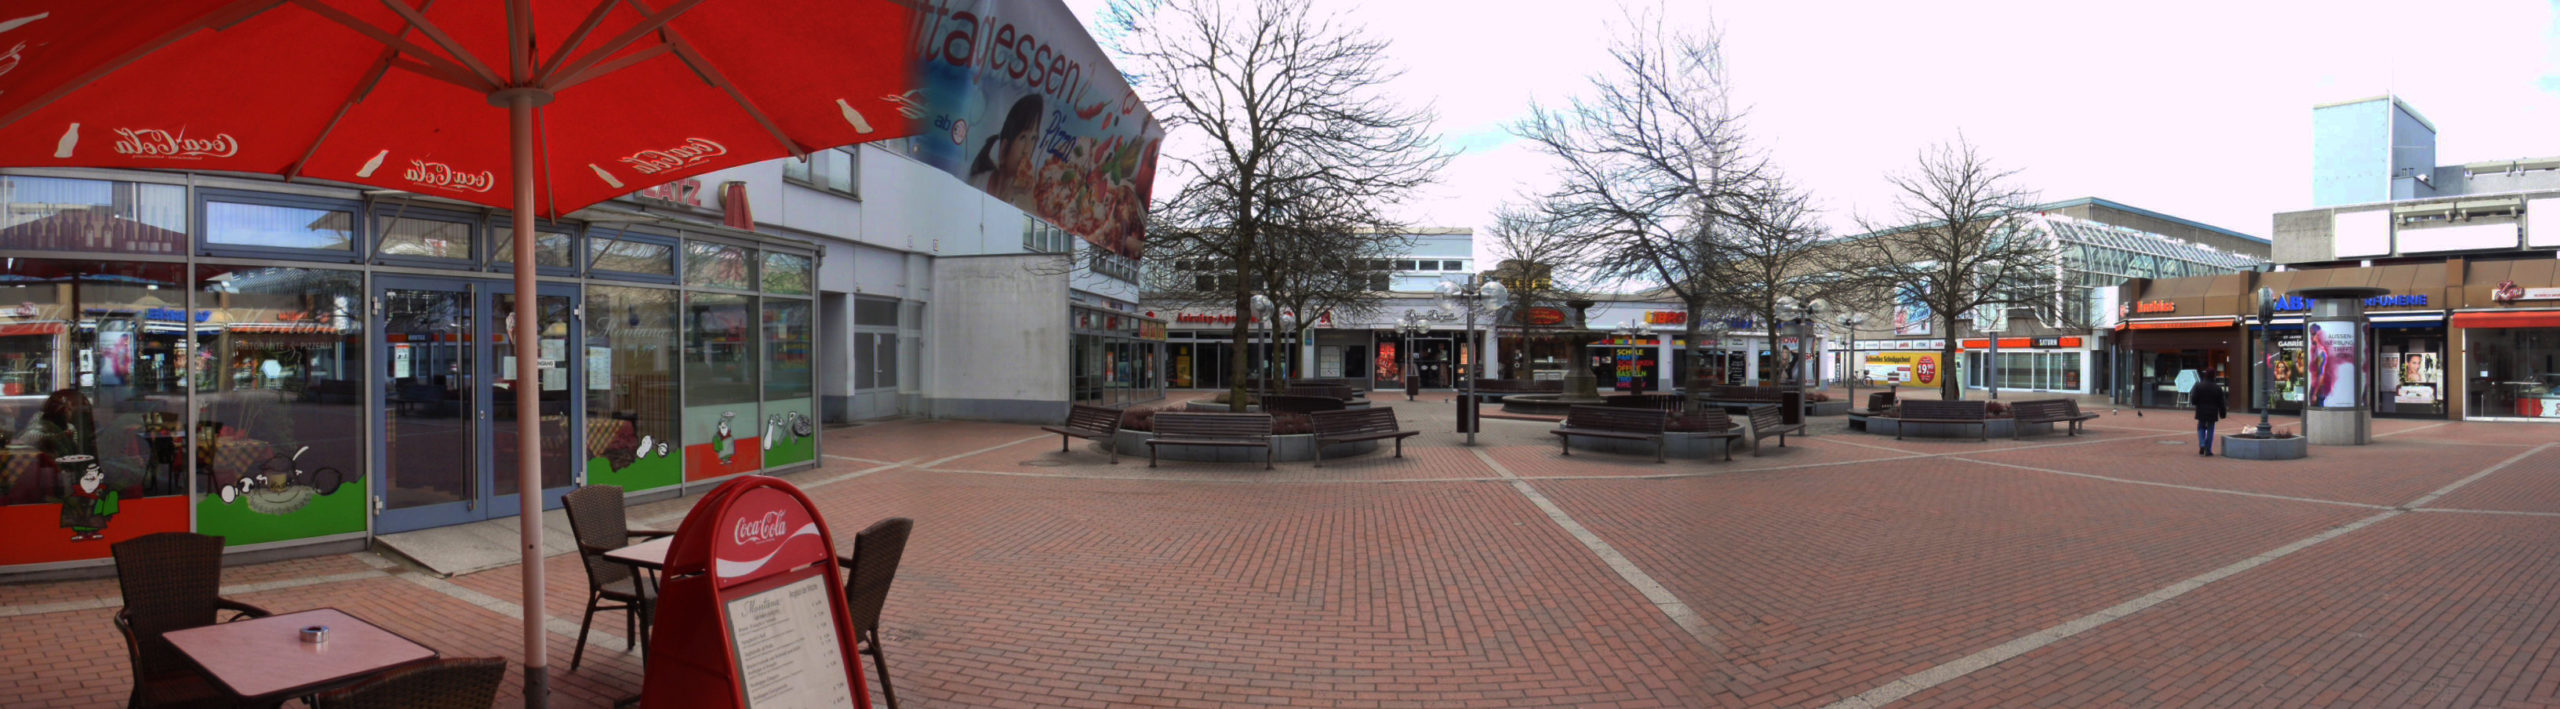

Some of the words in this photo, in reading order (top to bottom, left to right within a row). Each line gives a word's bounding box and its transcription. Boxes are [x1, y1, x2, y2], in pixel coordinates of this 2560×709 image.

[934, 113, 951, 131] ab
[1039, 109, 1077, 163] Pizza
[2039, 338, 2058, 346] SATURN
[734, 509, 787, 546] Coca-Cola
